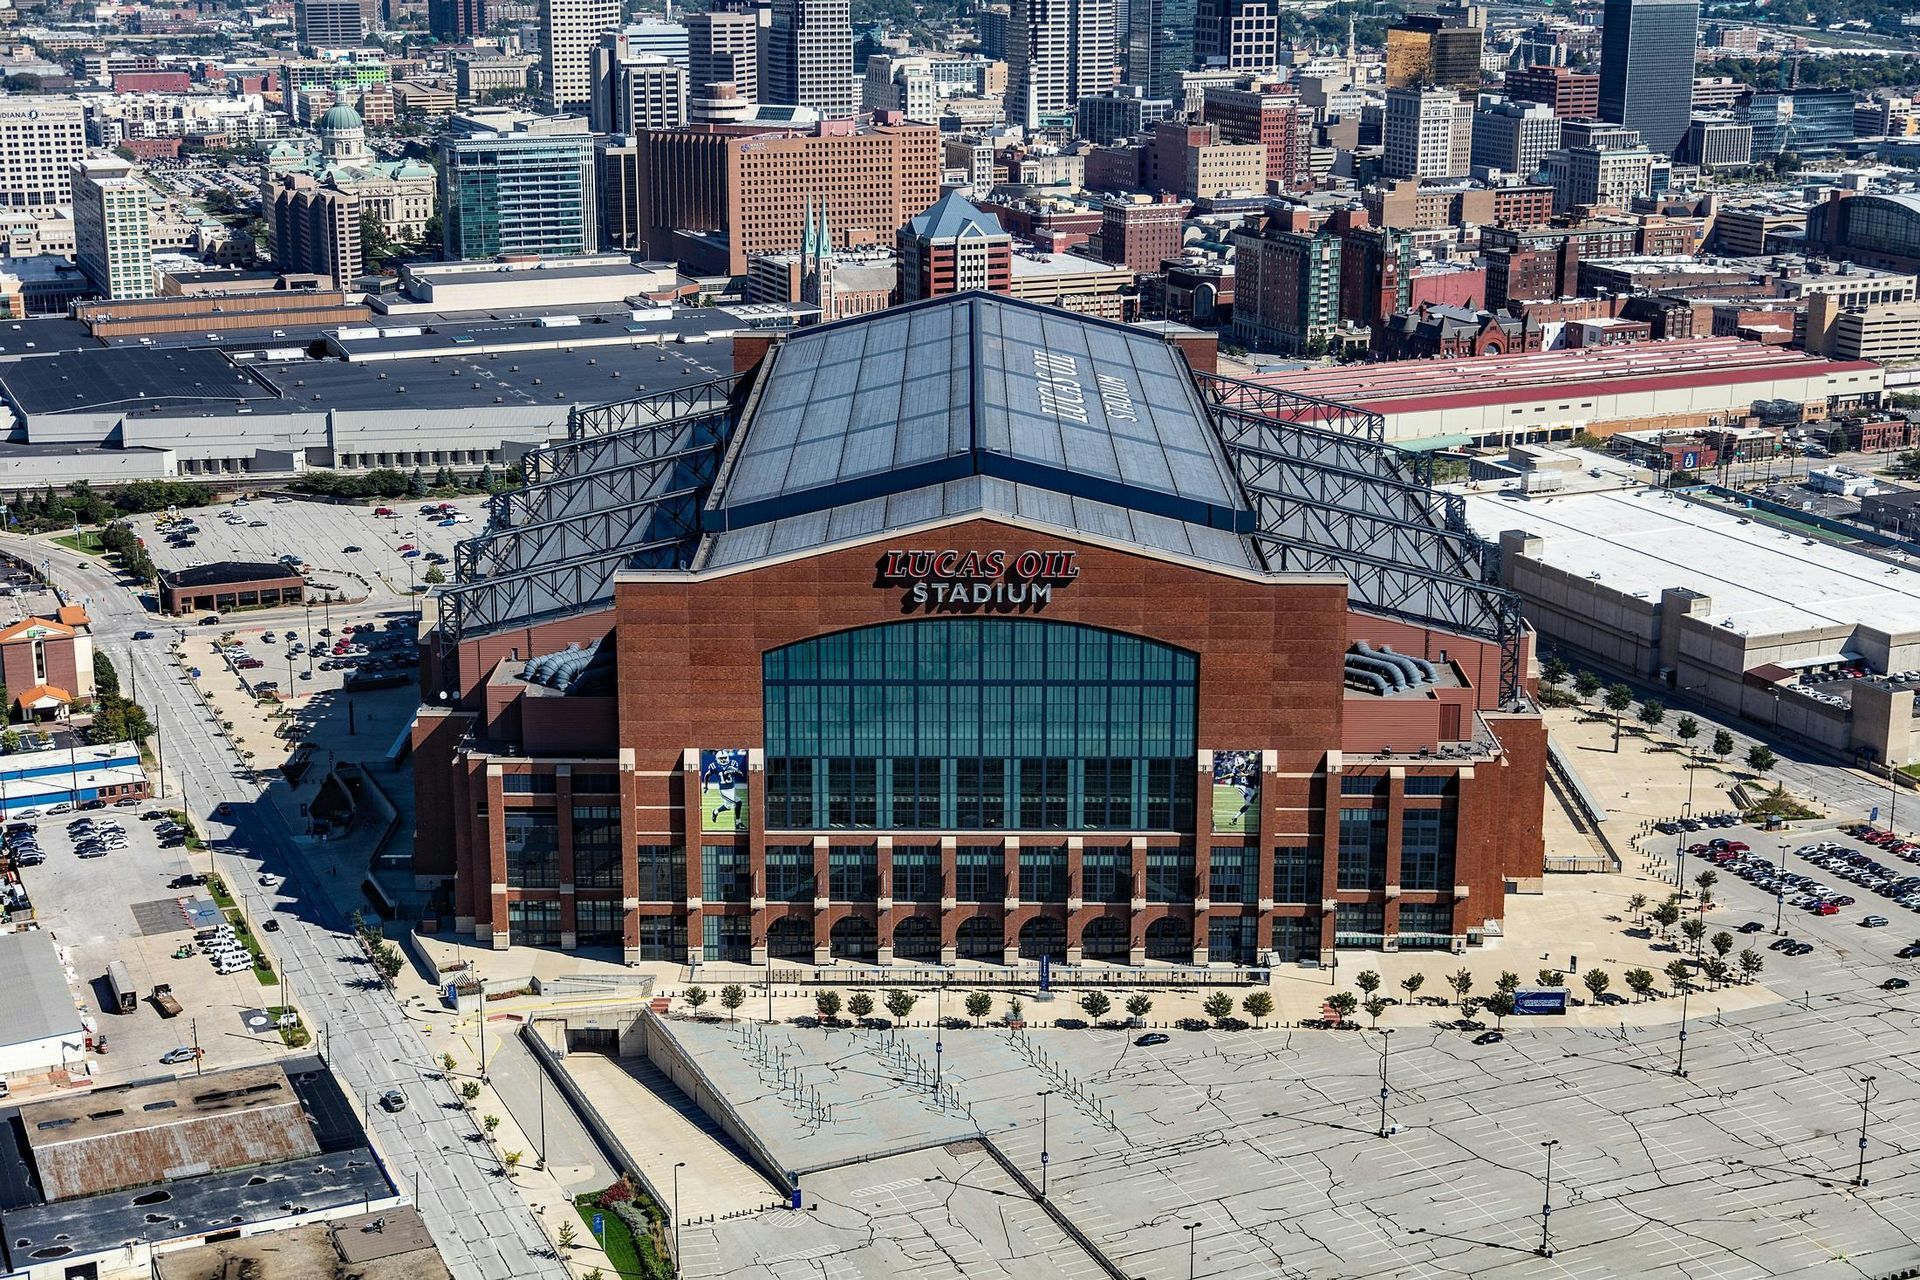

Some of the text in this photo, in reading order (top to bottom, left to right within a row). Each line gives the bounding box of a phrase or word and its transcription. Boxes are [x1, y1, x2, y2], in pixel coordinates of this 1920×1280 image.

[1033, 349, 1089, 424] LUCAS OIL
[1097, 373, 1138, 423] STADIUM
[884, 550, 1081, 578] LUCAS OIL
[913, 582, 1052, 603] STADIUM
